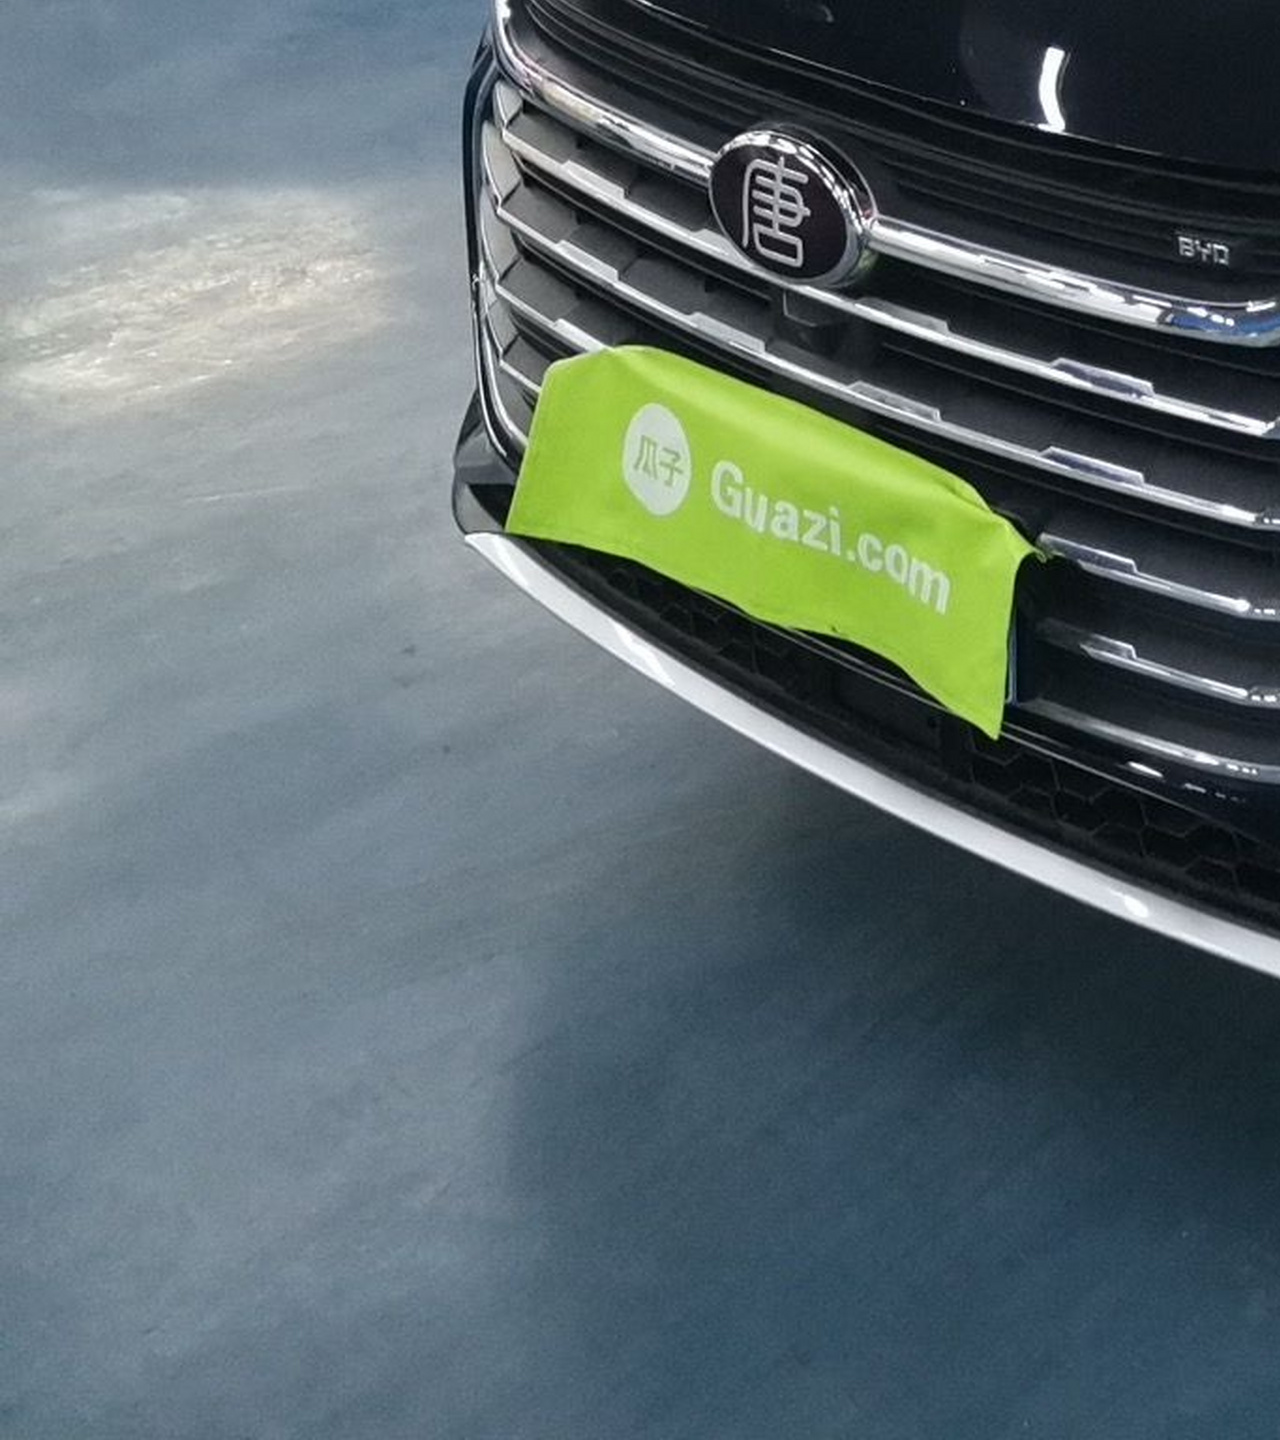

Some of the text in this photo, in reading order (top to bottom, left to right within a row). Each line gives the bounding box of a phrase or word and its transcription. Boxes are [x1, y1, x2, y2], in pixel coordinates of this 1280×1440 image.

[742, 156, 811, 268] 唐
[1178, 236, 1229, 265] BYD
[633, 435, 684, 488] 瓜子
[710, 459, 951, 616] Guazi.com
